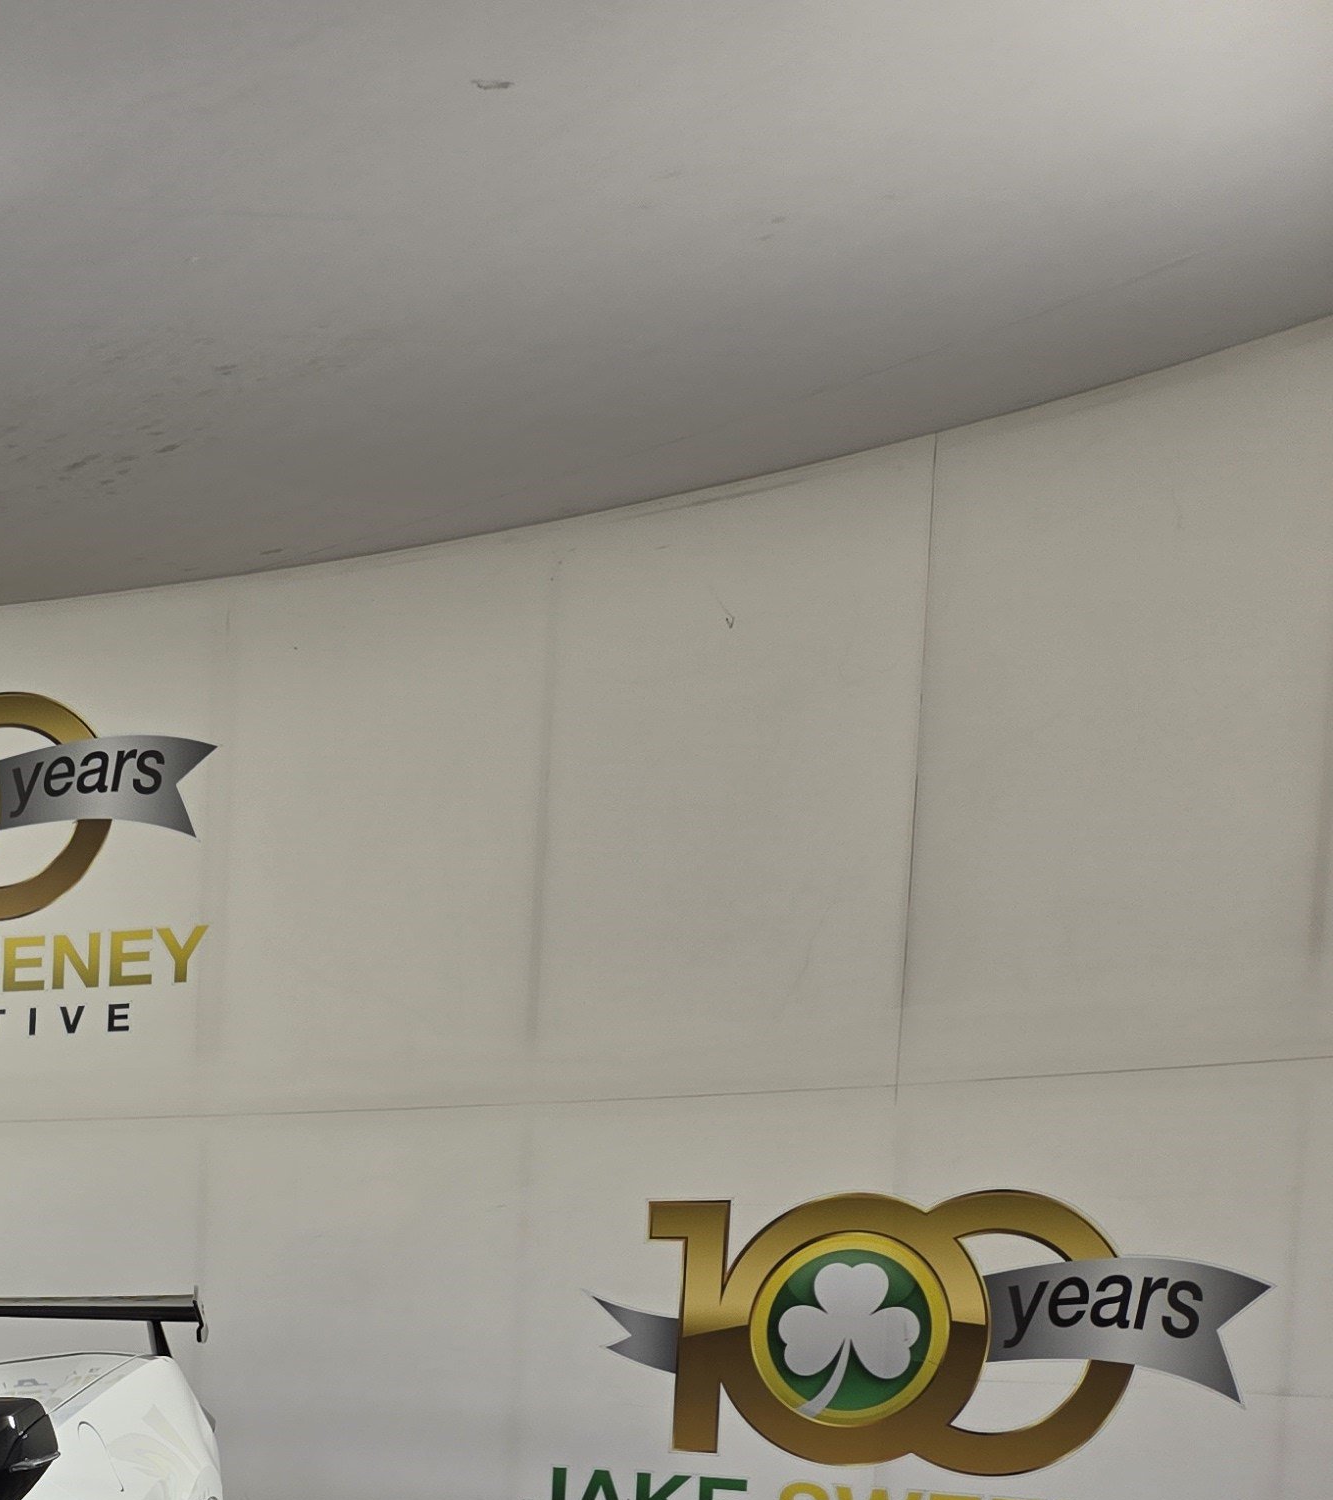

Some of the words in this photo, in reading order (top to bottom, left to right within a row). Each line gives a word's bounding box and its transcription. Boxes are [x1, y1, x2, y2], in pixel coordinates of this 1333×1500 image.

[10, 746, 164, 817] years
[648, 1188, 1135, 1476] 100
[1004, 1274, 1203, 1349] years
